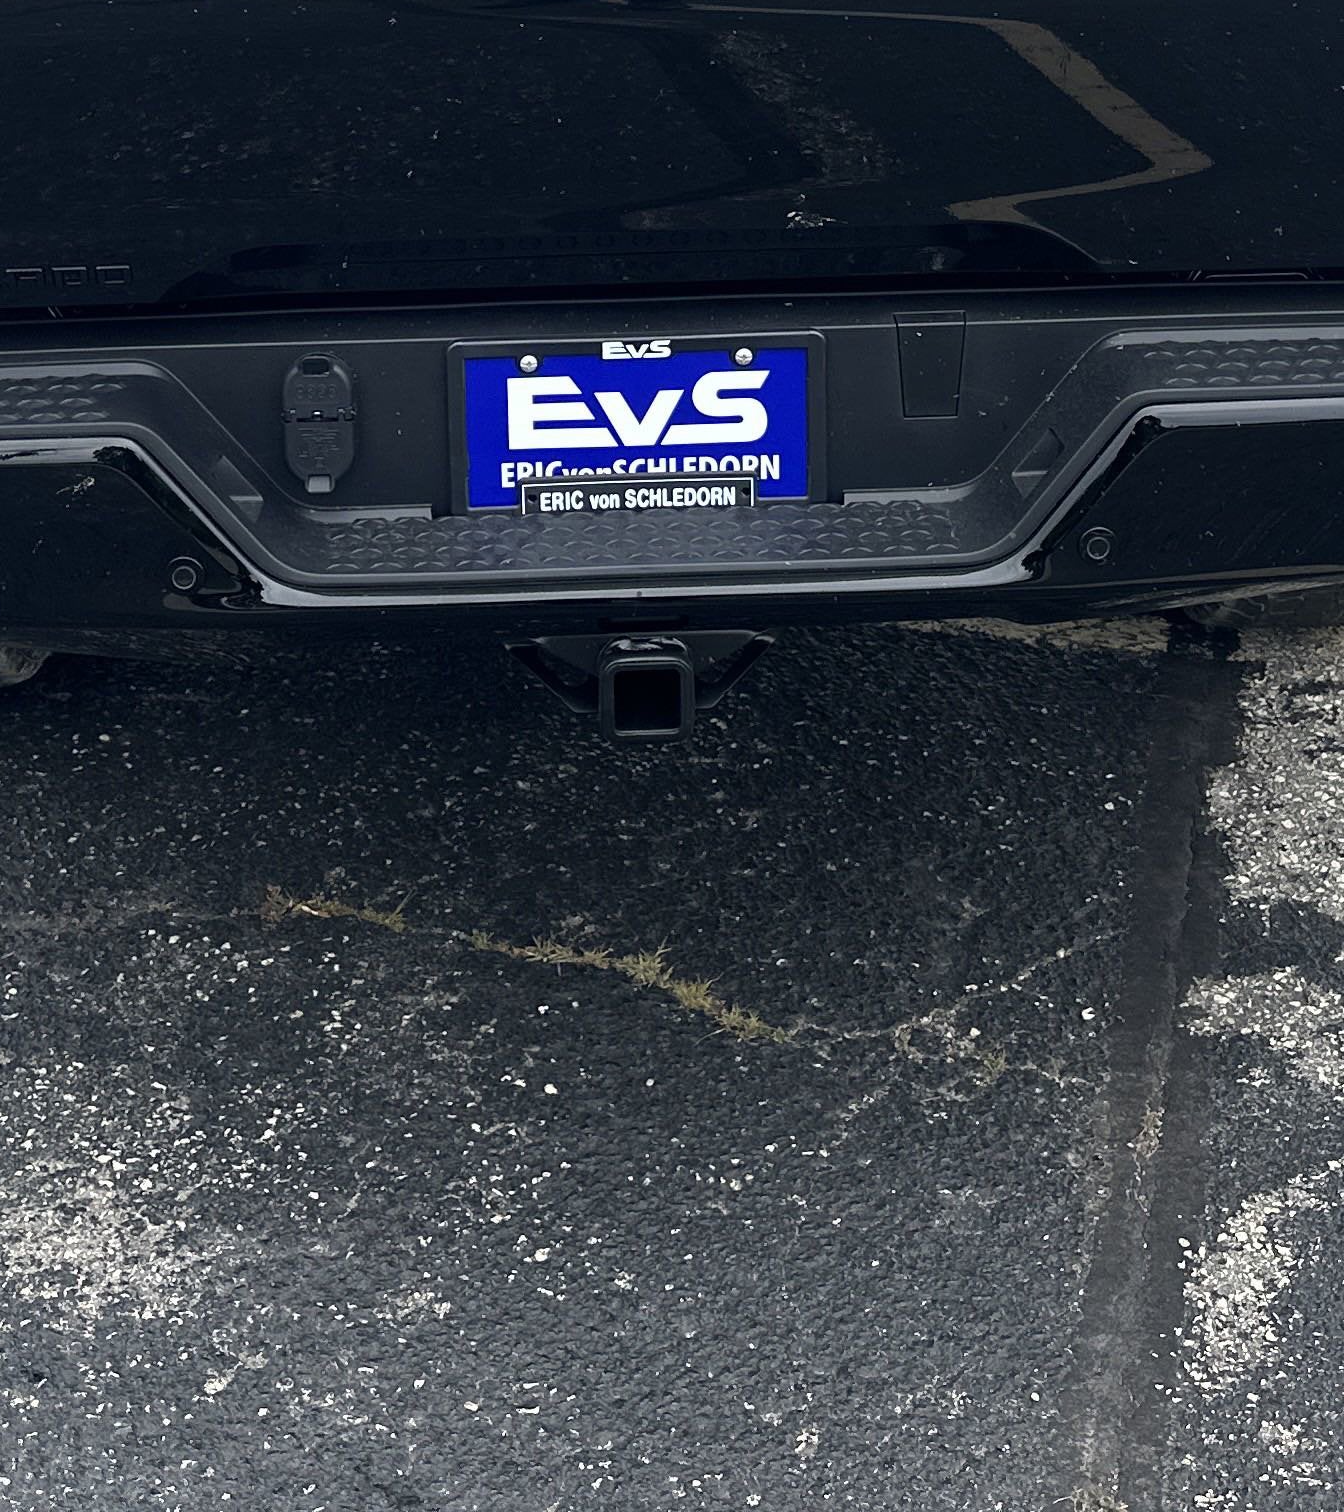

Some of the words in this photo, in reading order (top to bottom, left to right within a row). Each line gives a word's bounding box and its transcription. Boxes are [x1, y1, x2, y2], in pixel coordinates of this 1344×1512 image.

[540, 490, 584, 512] ERIC
[589, 493, 620, 509] von
[624, 486, 736, 508] SCHLEDORN
